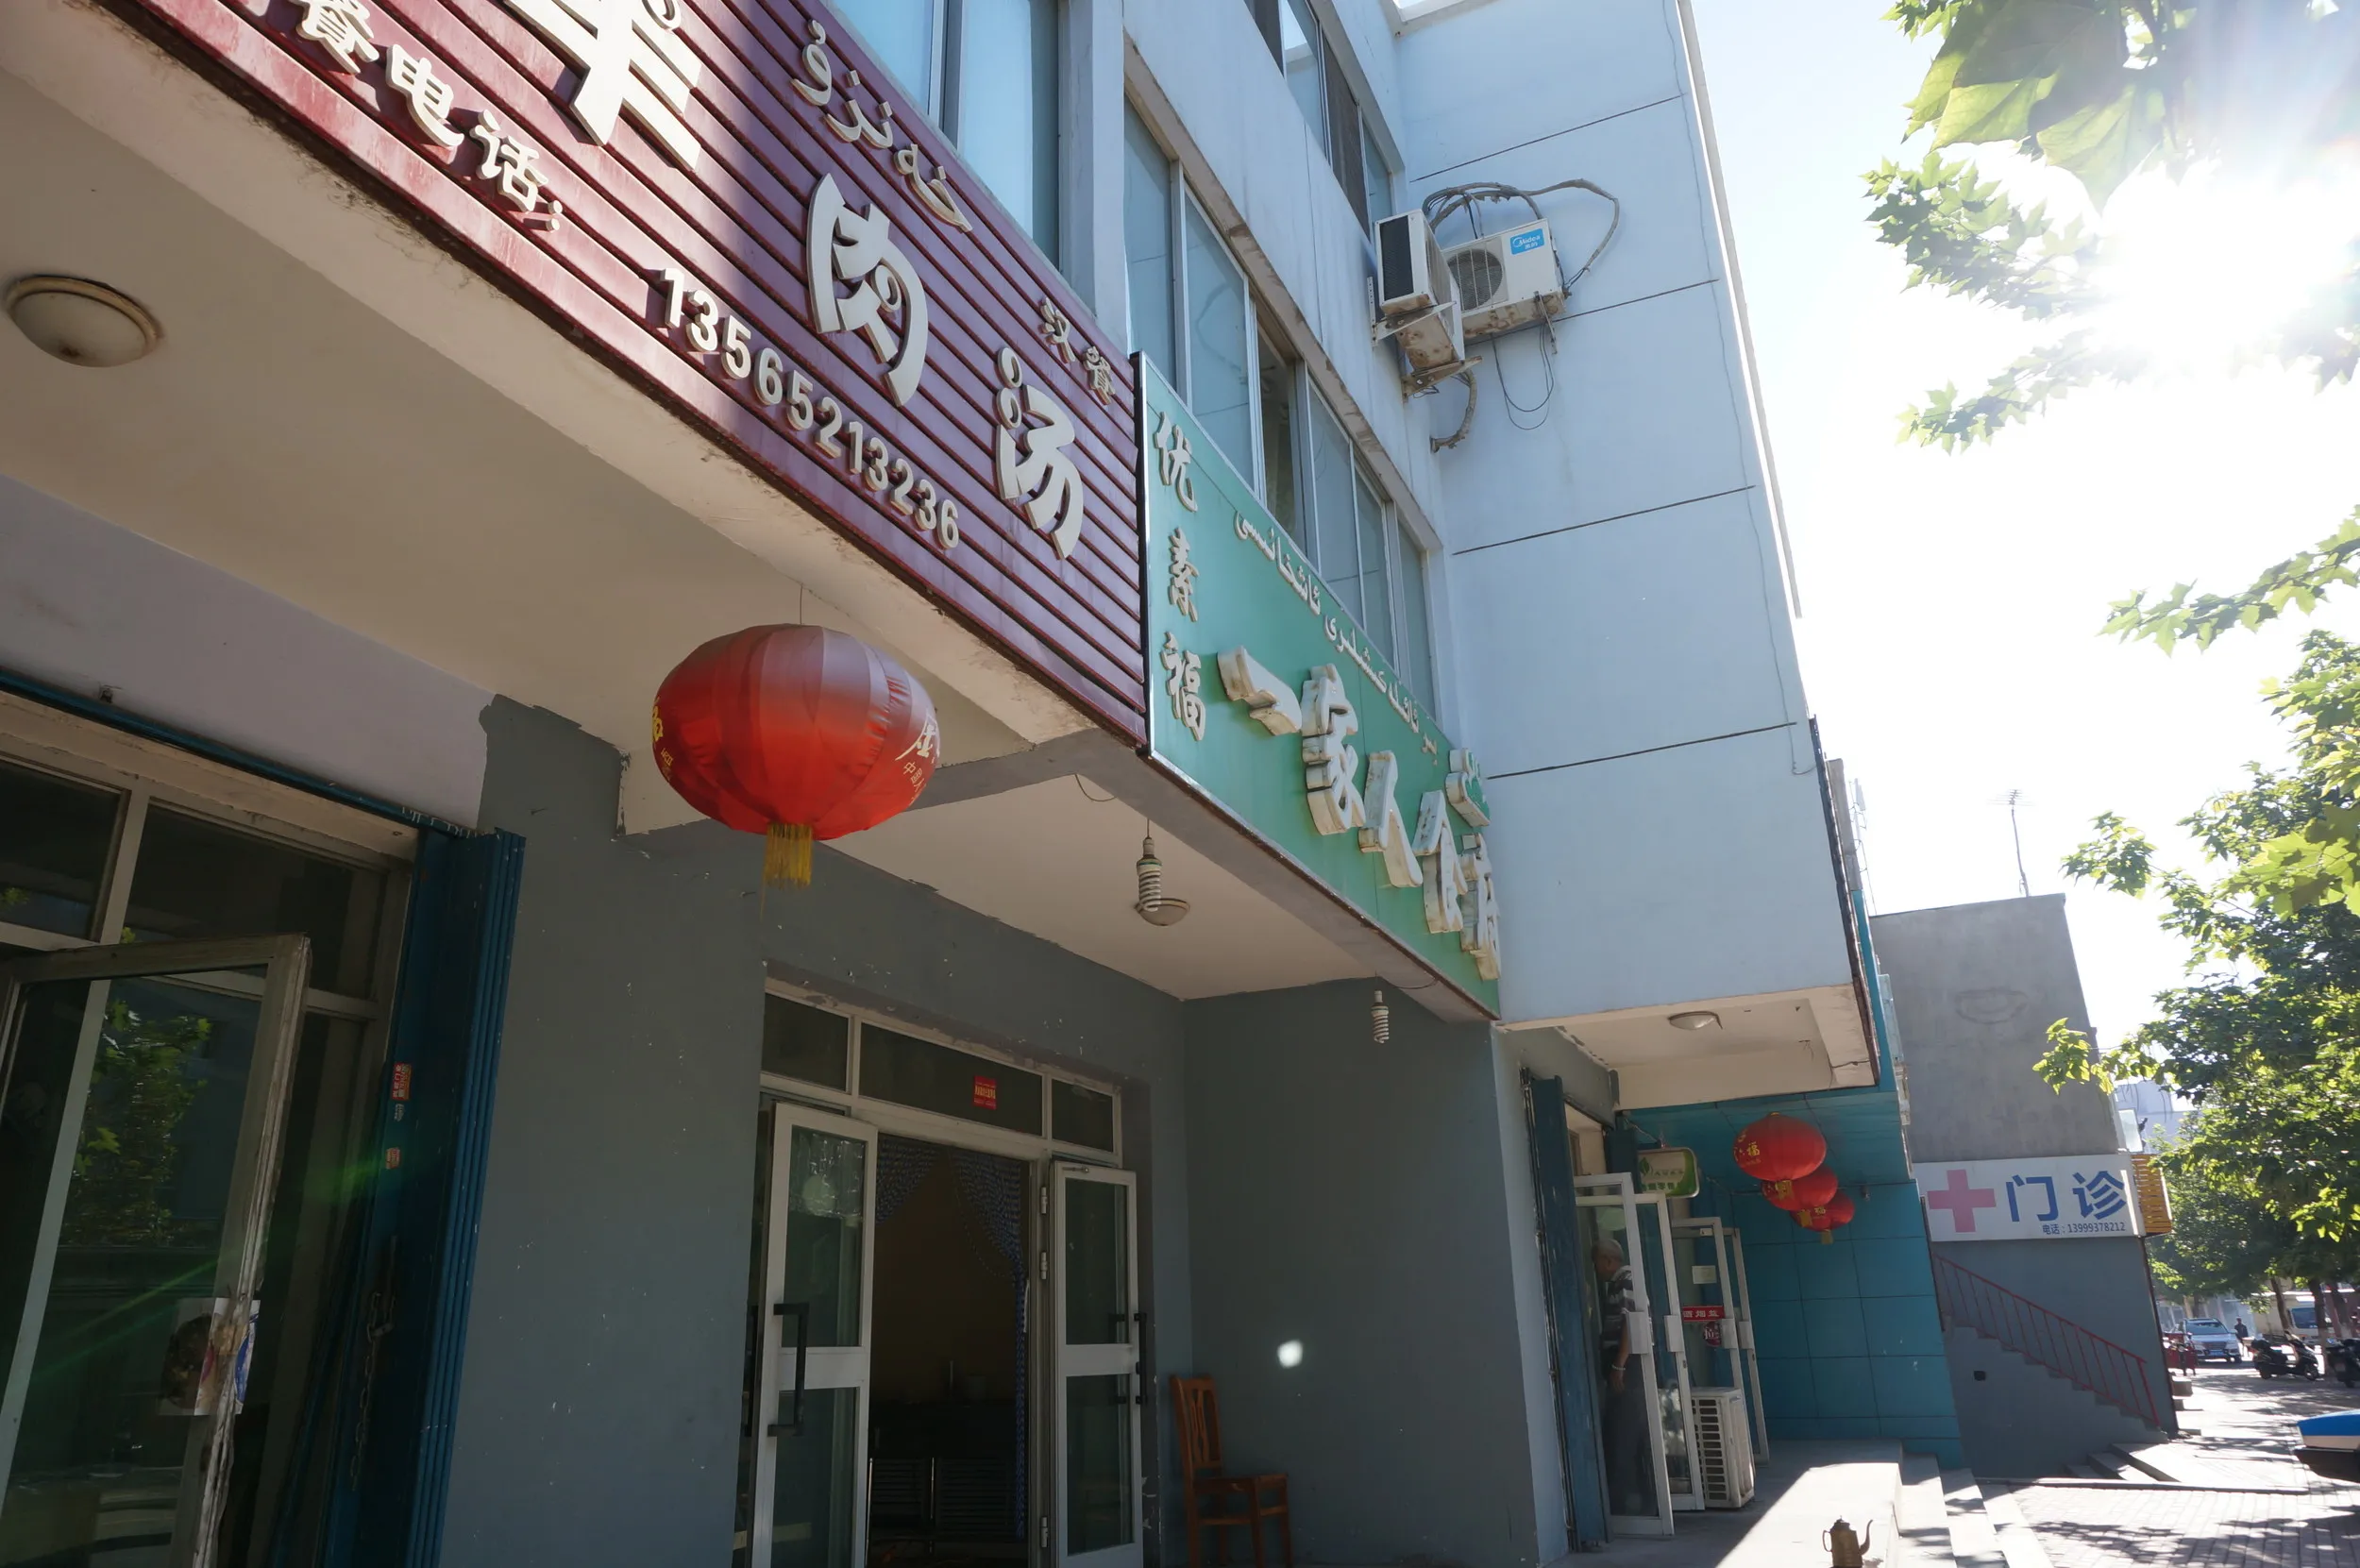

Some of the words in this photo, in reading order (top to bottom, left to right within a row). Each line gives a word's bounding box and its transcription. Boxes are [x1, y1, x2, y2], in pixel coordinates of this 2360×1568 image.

[660, 268, 959, 549] 13565213236
[1037, 296, 1116, 405] 汉餐
[1154, 411, 1206, 742] 优素福
[1217, 646, 1501, 981] 一家人食府
[2005, 1171, 2127, 1222] 门诊
